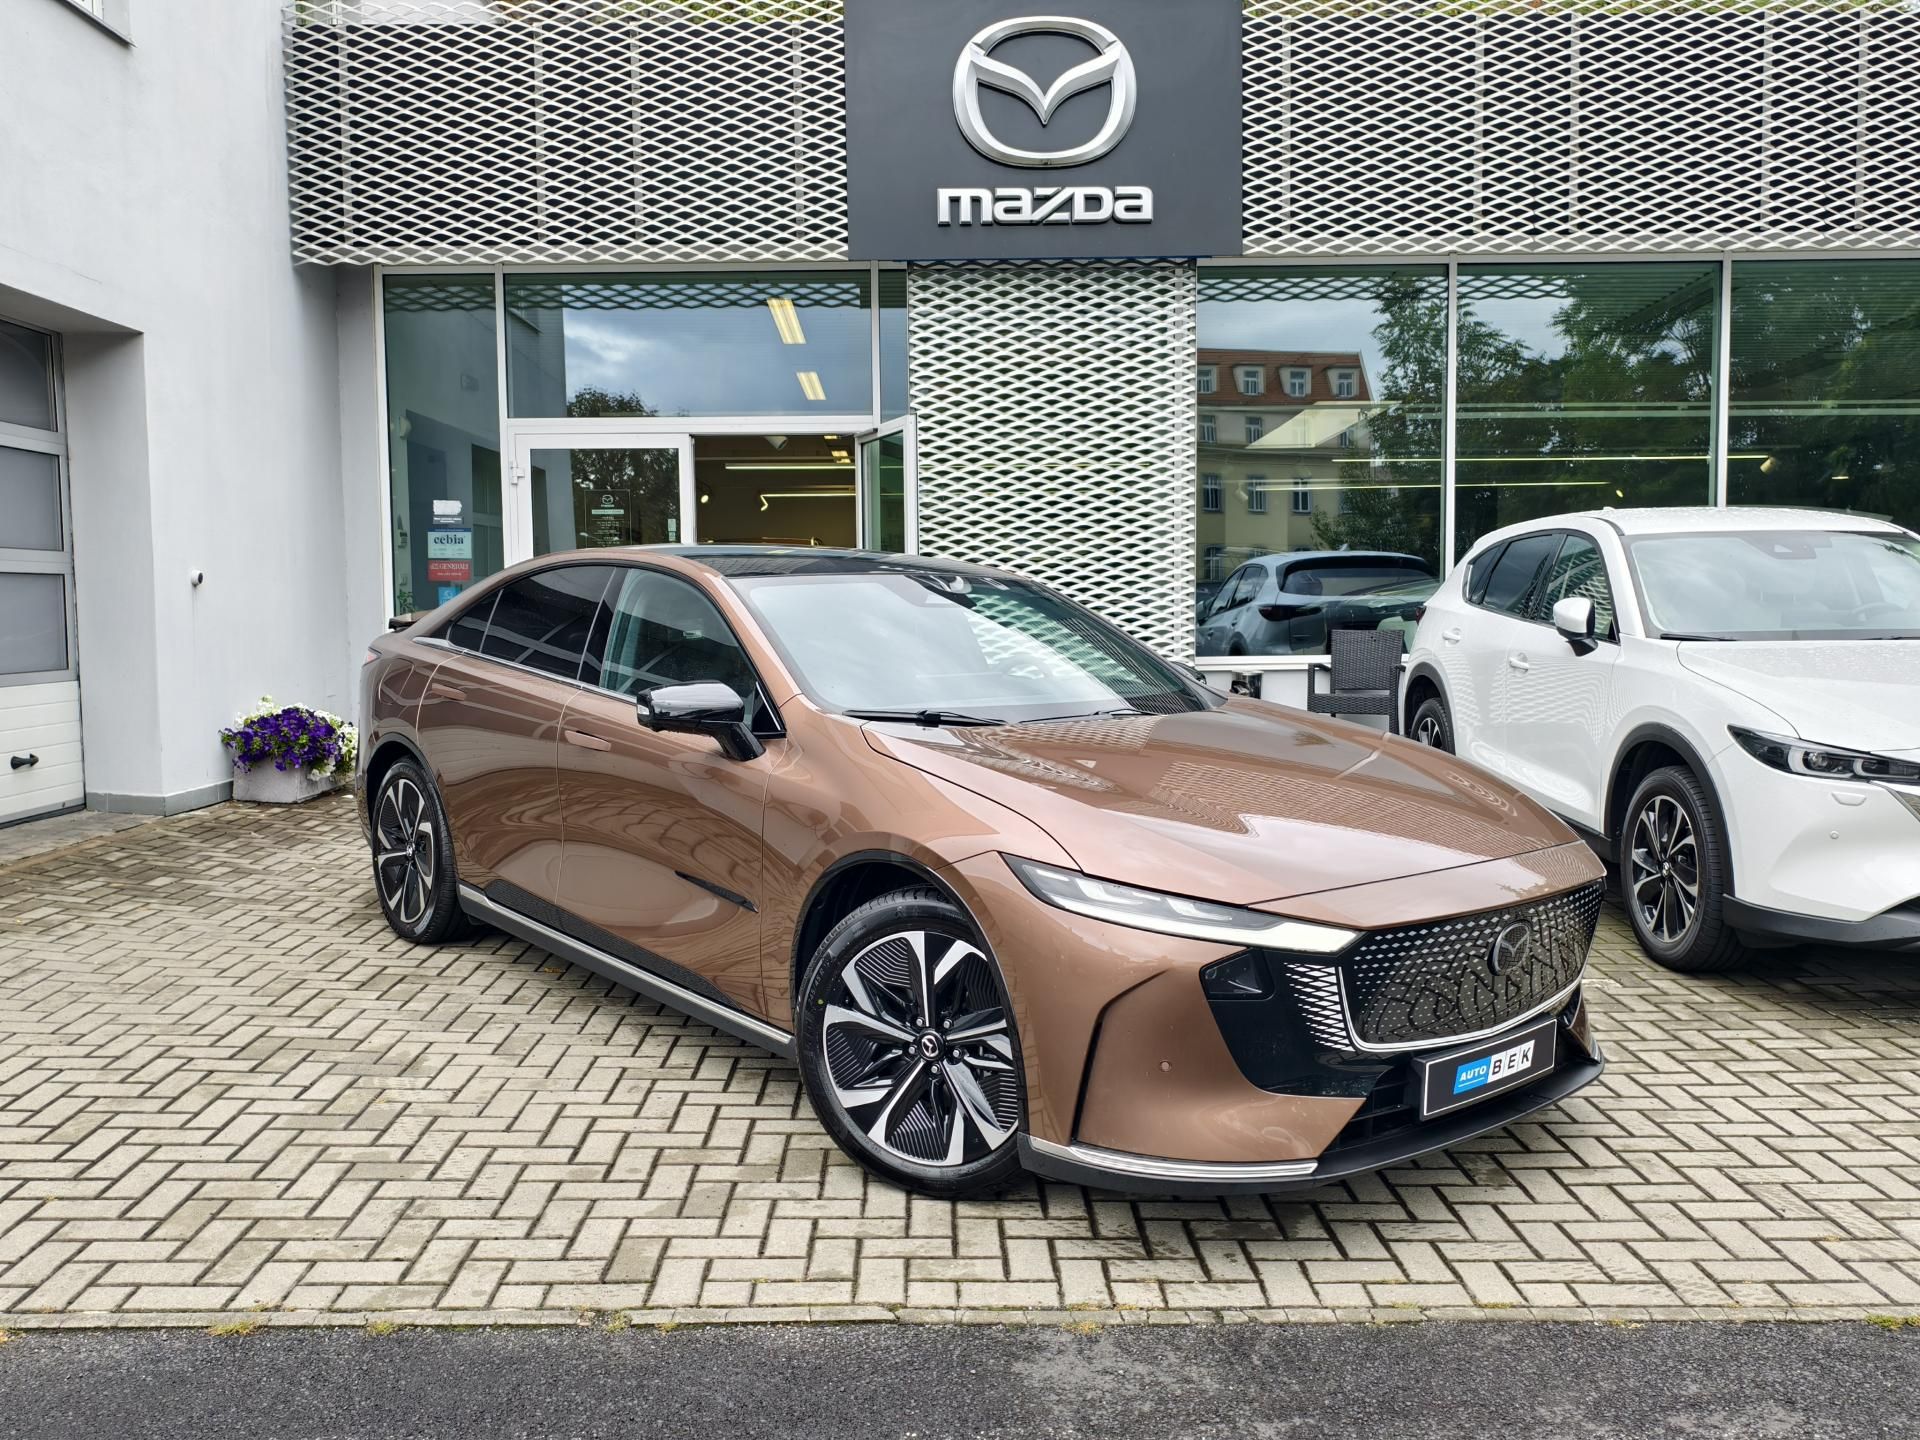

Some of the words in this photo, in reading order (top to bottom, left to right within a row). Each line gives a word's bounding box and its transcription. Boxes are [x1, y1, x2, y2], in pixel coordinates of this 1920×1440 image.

[434, 534, 464, 545] cebia
[1460, 1065, 1487, 1081] AUTO
[1491, 1047, 1531, 1076] BEK
